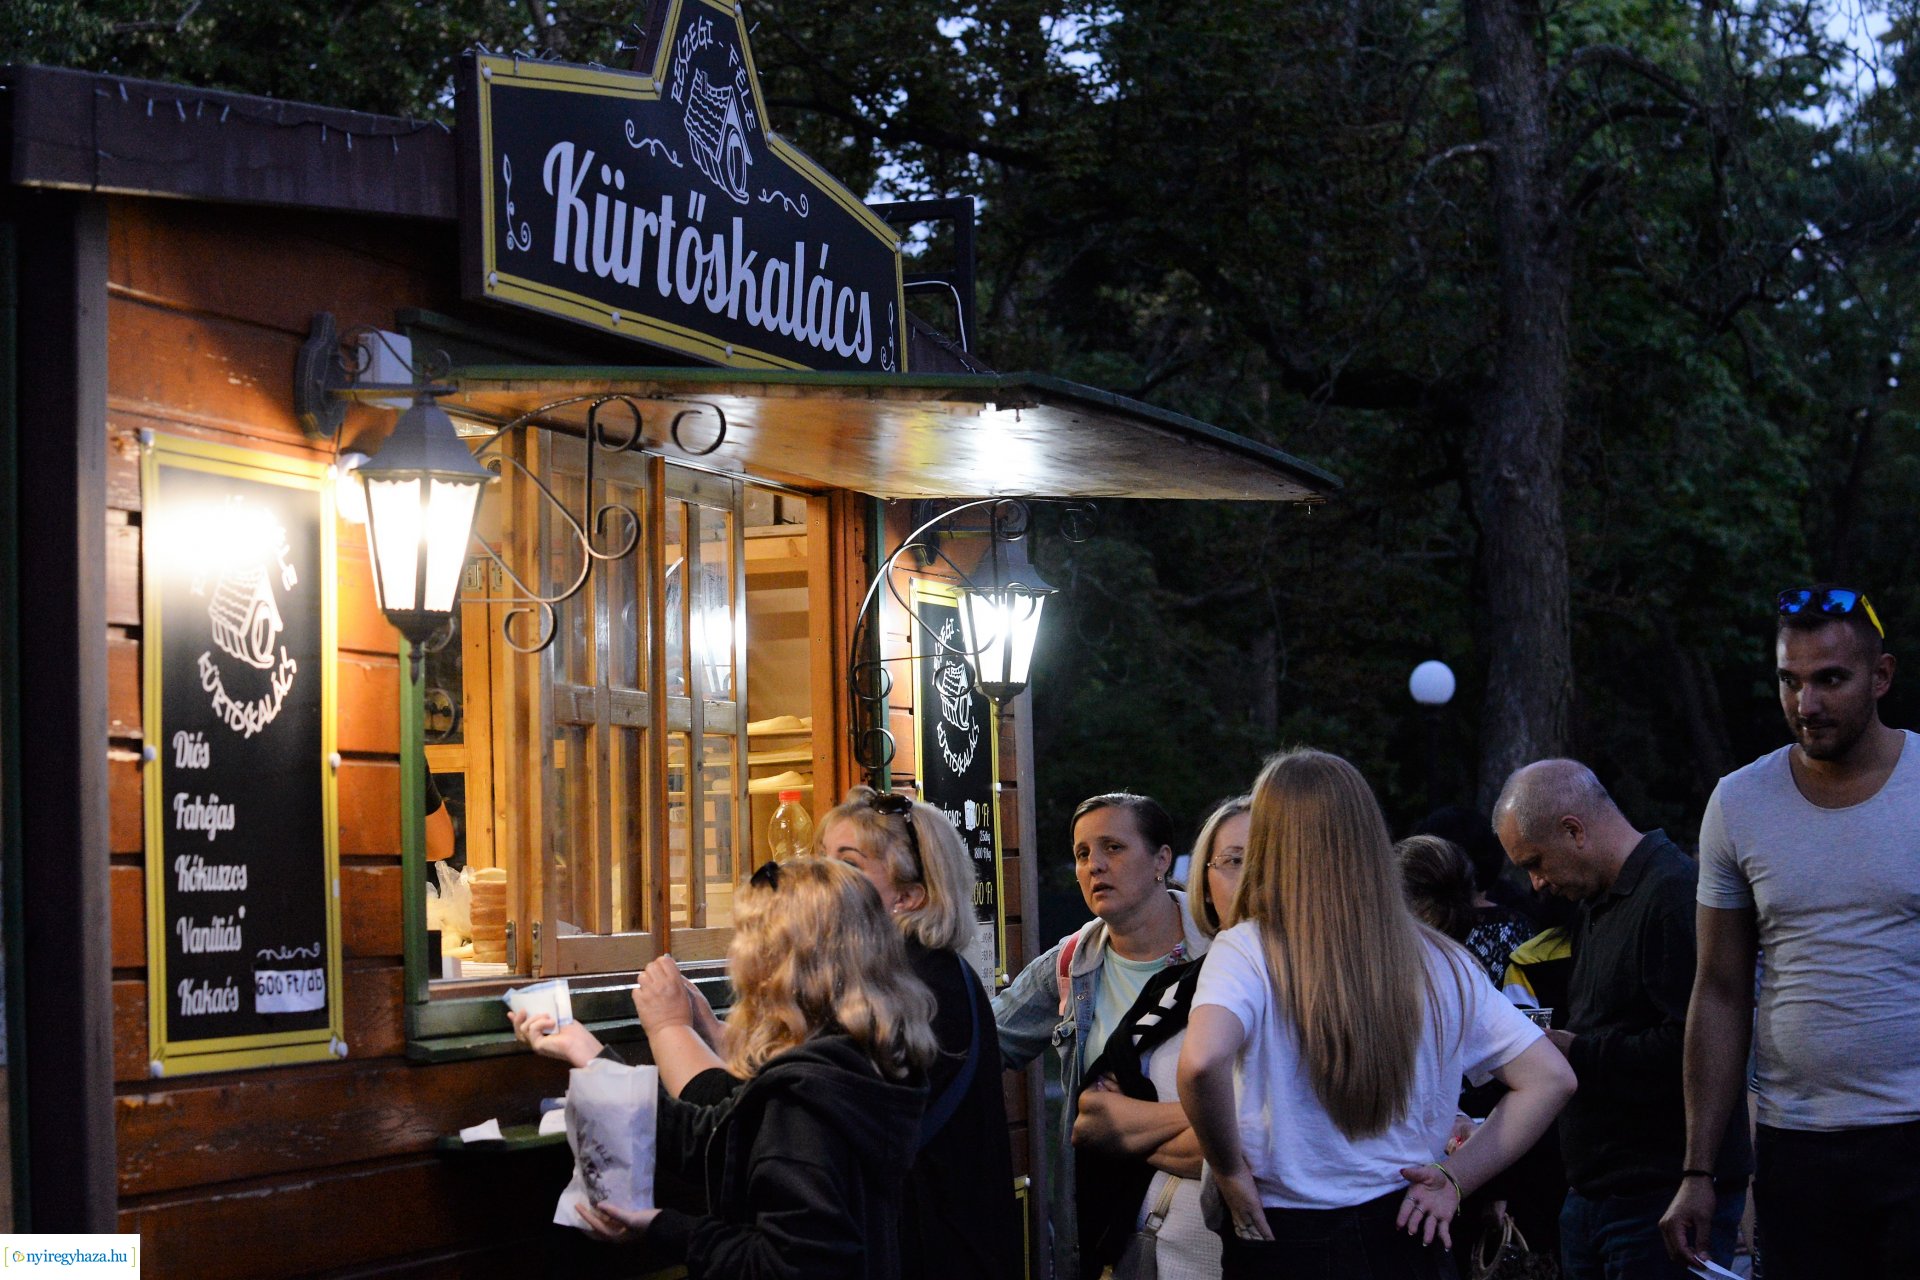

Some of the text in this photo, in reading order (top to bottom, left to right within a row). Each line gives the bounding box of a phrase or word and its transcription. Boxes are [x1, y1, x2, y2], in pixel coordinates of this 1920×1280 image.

[542, 141, 873, 365] Kürtőskalács
[172, 729, 211, 770] Diós
[173, 791, 236, 842] Fahéjas
[174, 853, 248, 893] Kókuszos
[973, 881, 985, 906] 00
[176, 914, 243, 953] Vaníliás
[177, 975, 240, 1017] Kakaós
[256, 969, 324, 997] 600 Ft/db
